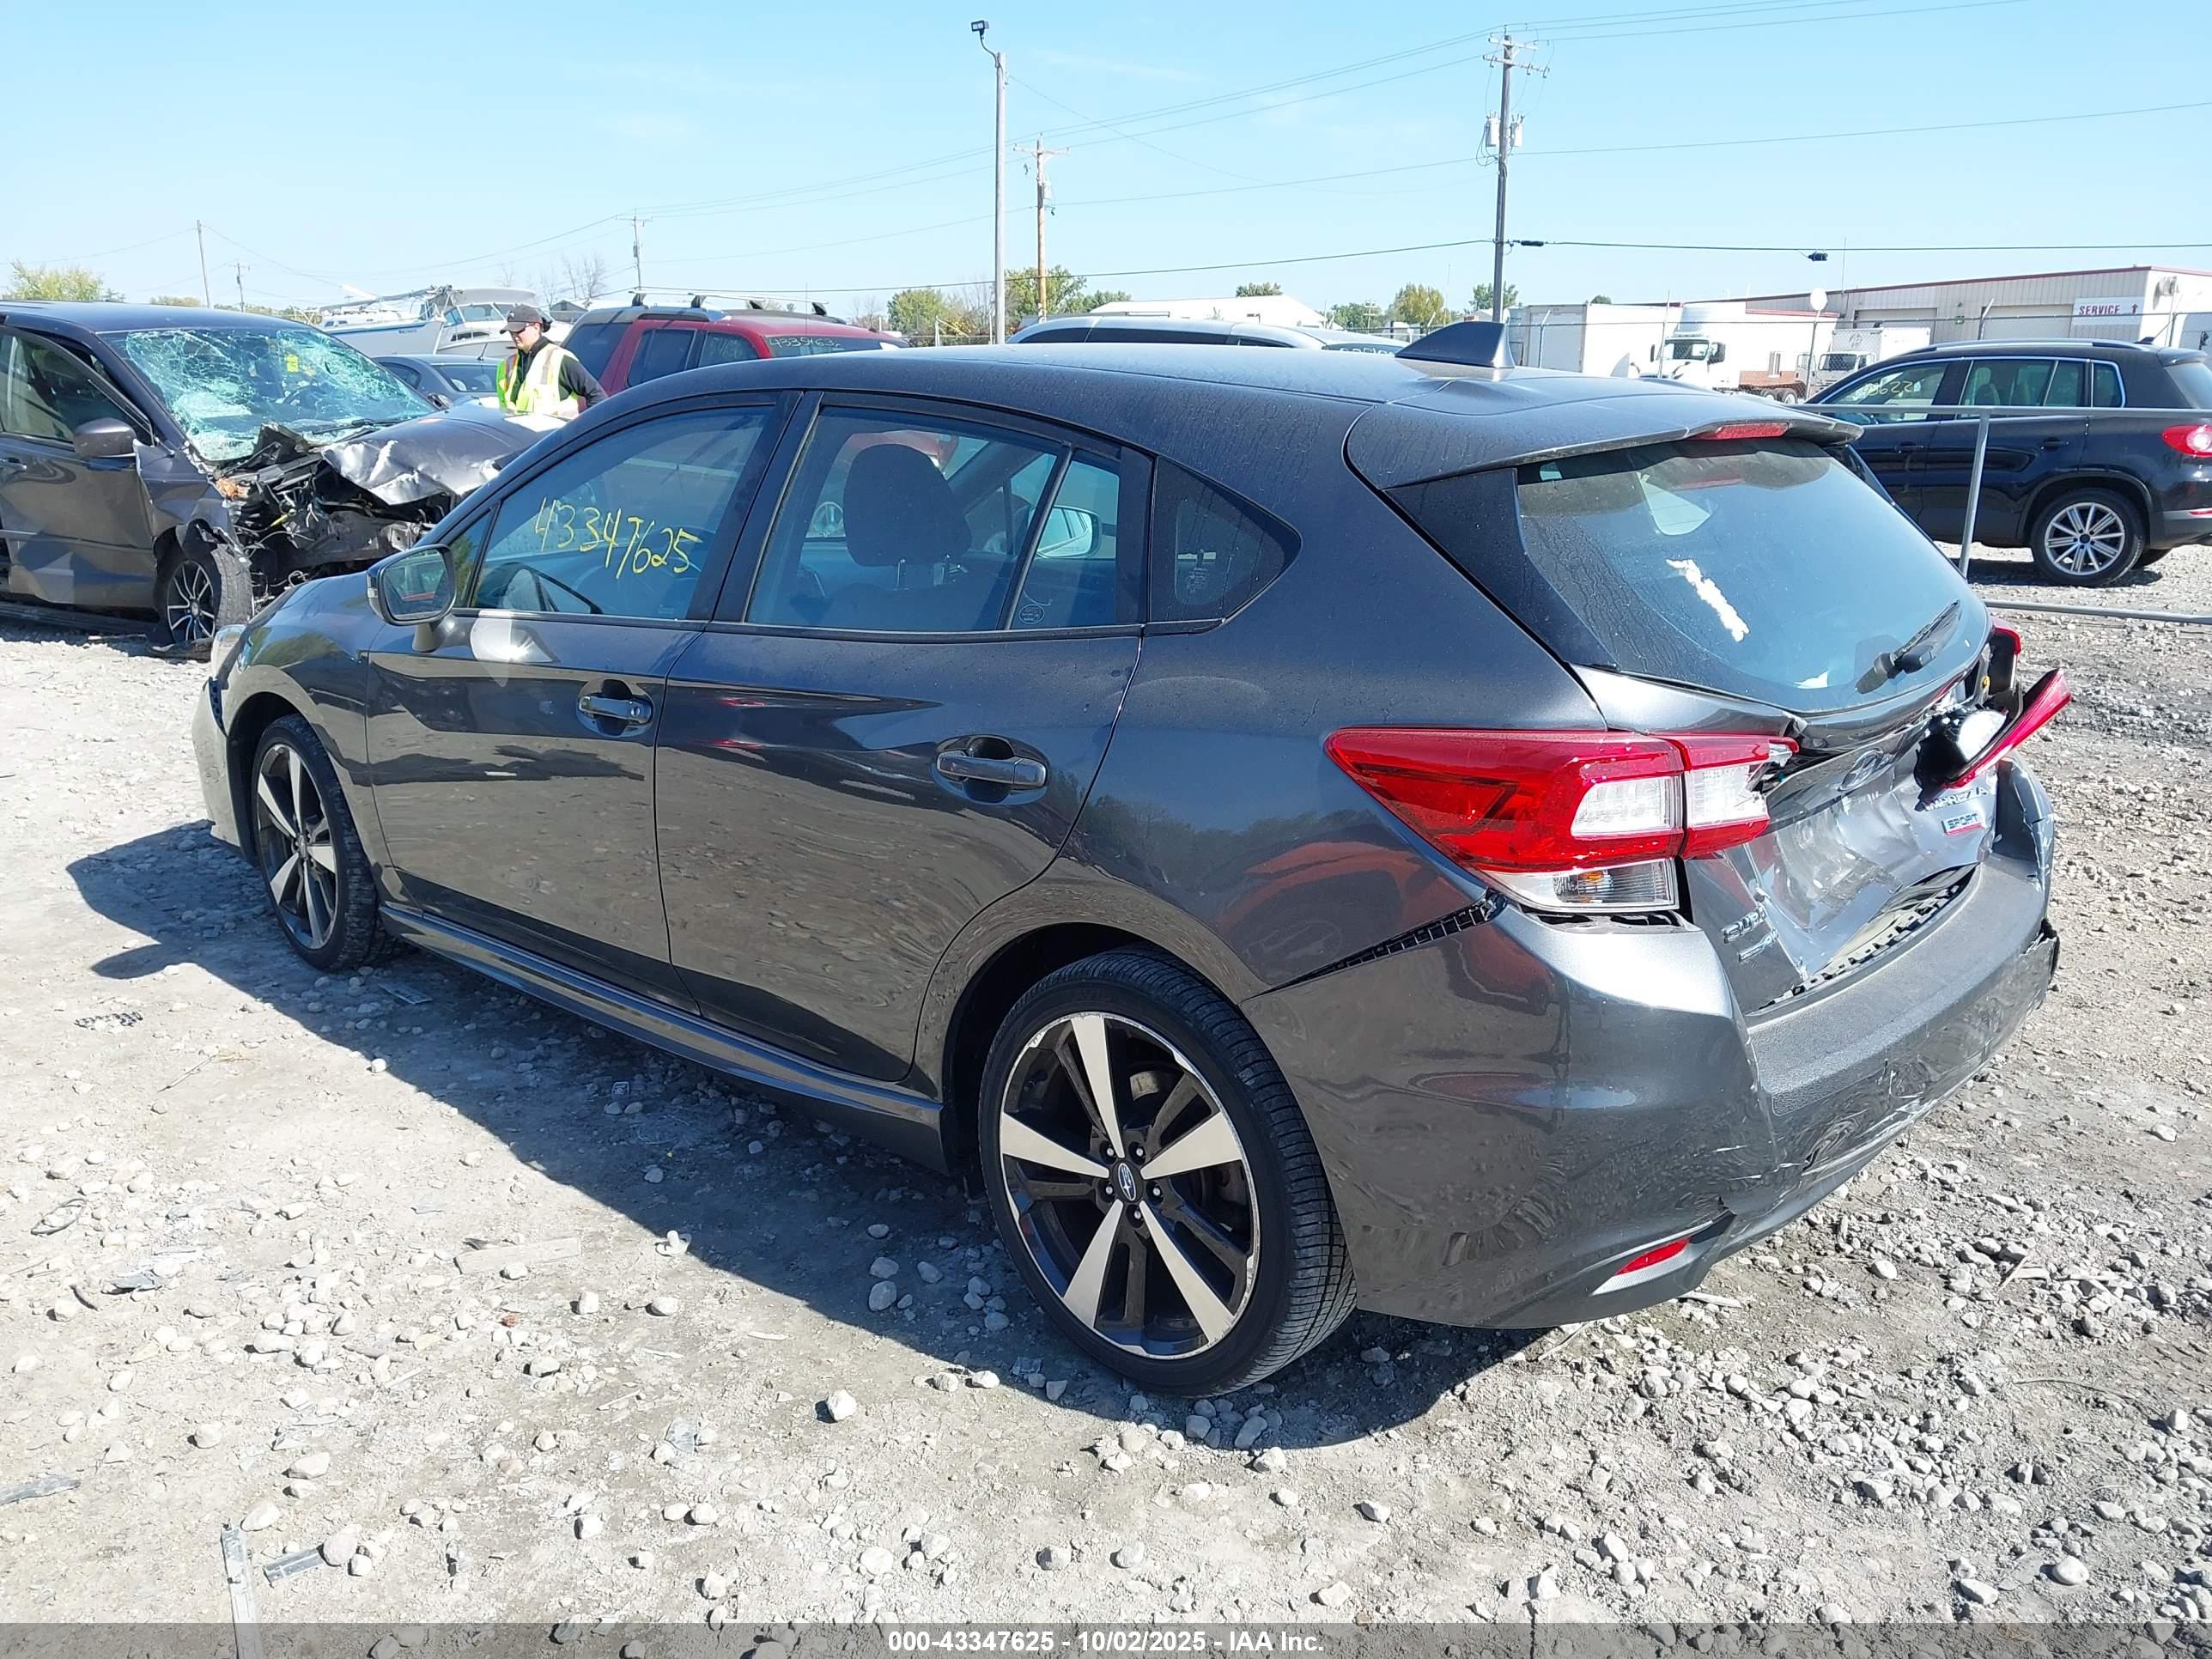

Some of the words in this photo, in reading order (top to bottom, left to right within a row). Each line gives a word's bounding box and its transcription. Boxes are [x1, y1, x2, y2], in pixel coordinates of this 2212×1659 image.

[2079, 305, 2120, 316] SERVICE
[534, 495, 703, 580] 43347625
[1947, 812, 1978, 829] SPORT
